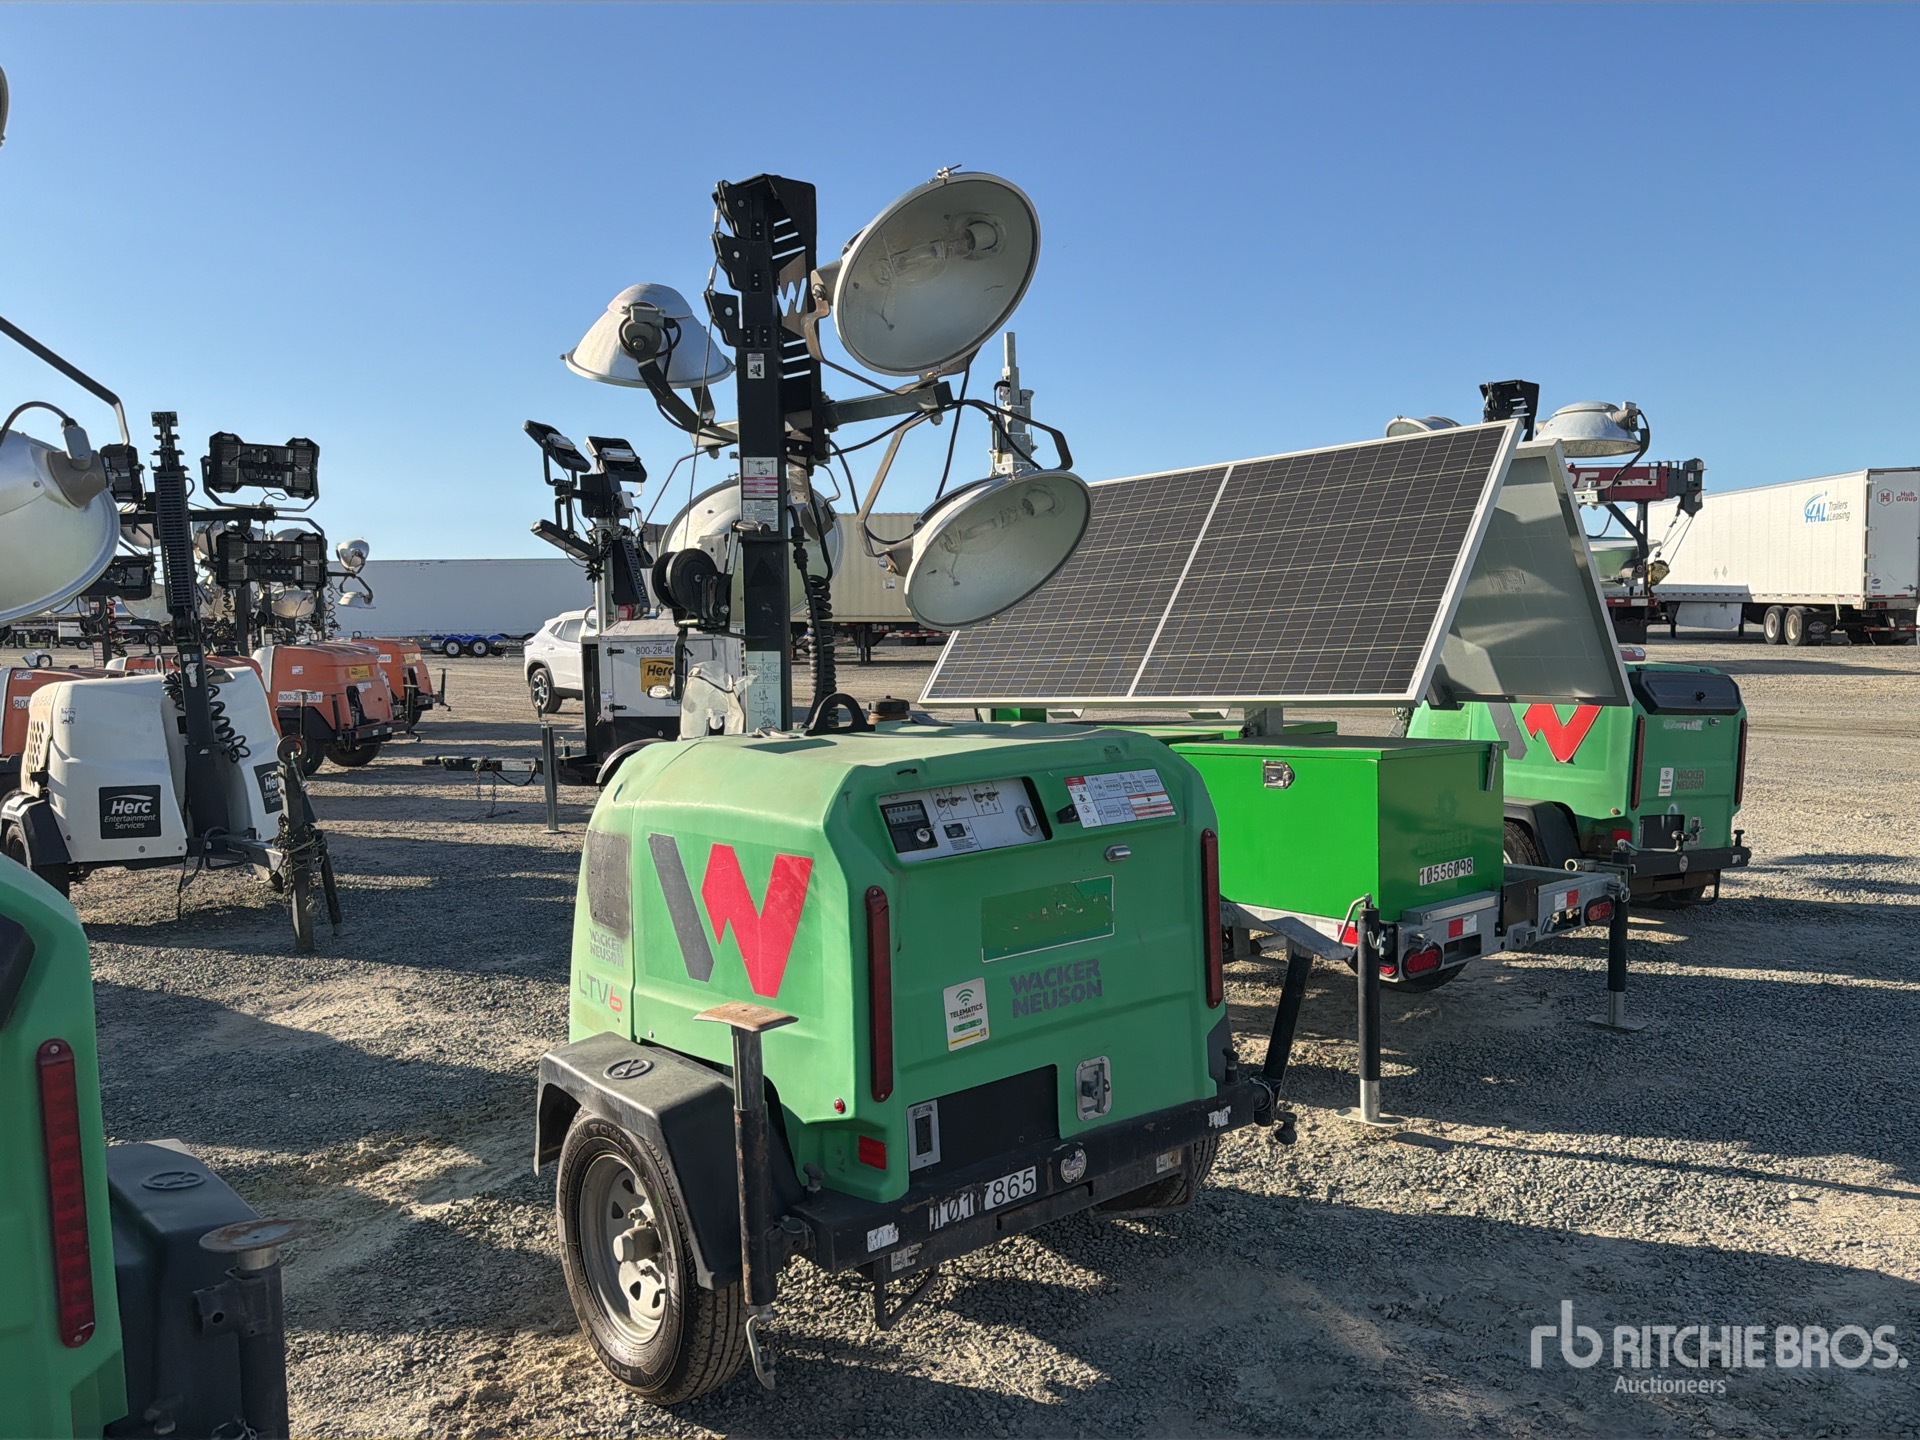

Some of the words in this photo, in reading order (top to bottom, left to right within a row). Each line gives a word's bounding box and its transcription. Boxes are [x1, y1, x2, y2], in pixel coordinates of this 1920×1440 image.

[1828, 501, 1849, 512] Trailers
[1830, 511, 1851, 522] Leasing
[647, 664, 675, 677] Herc
[111, 800, 152, 814] Herc
[104, 814, 156, 823] Entertainment
[114, 821, 145, 830] Services
[1419, 858, 1473, 885] 10556098
[1010, 959, 1101, 995] WACKER
[578, 969, 623, 1013] LTV6
[1012, 979, 1103, 1019] NEUSON
[949, 1003, 984, 1019] TELEMATICS
